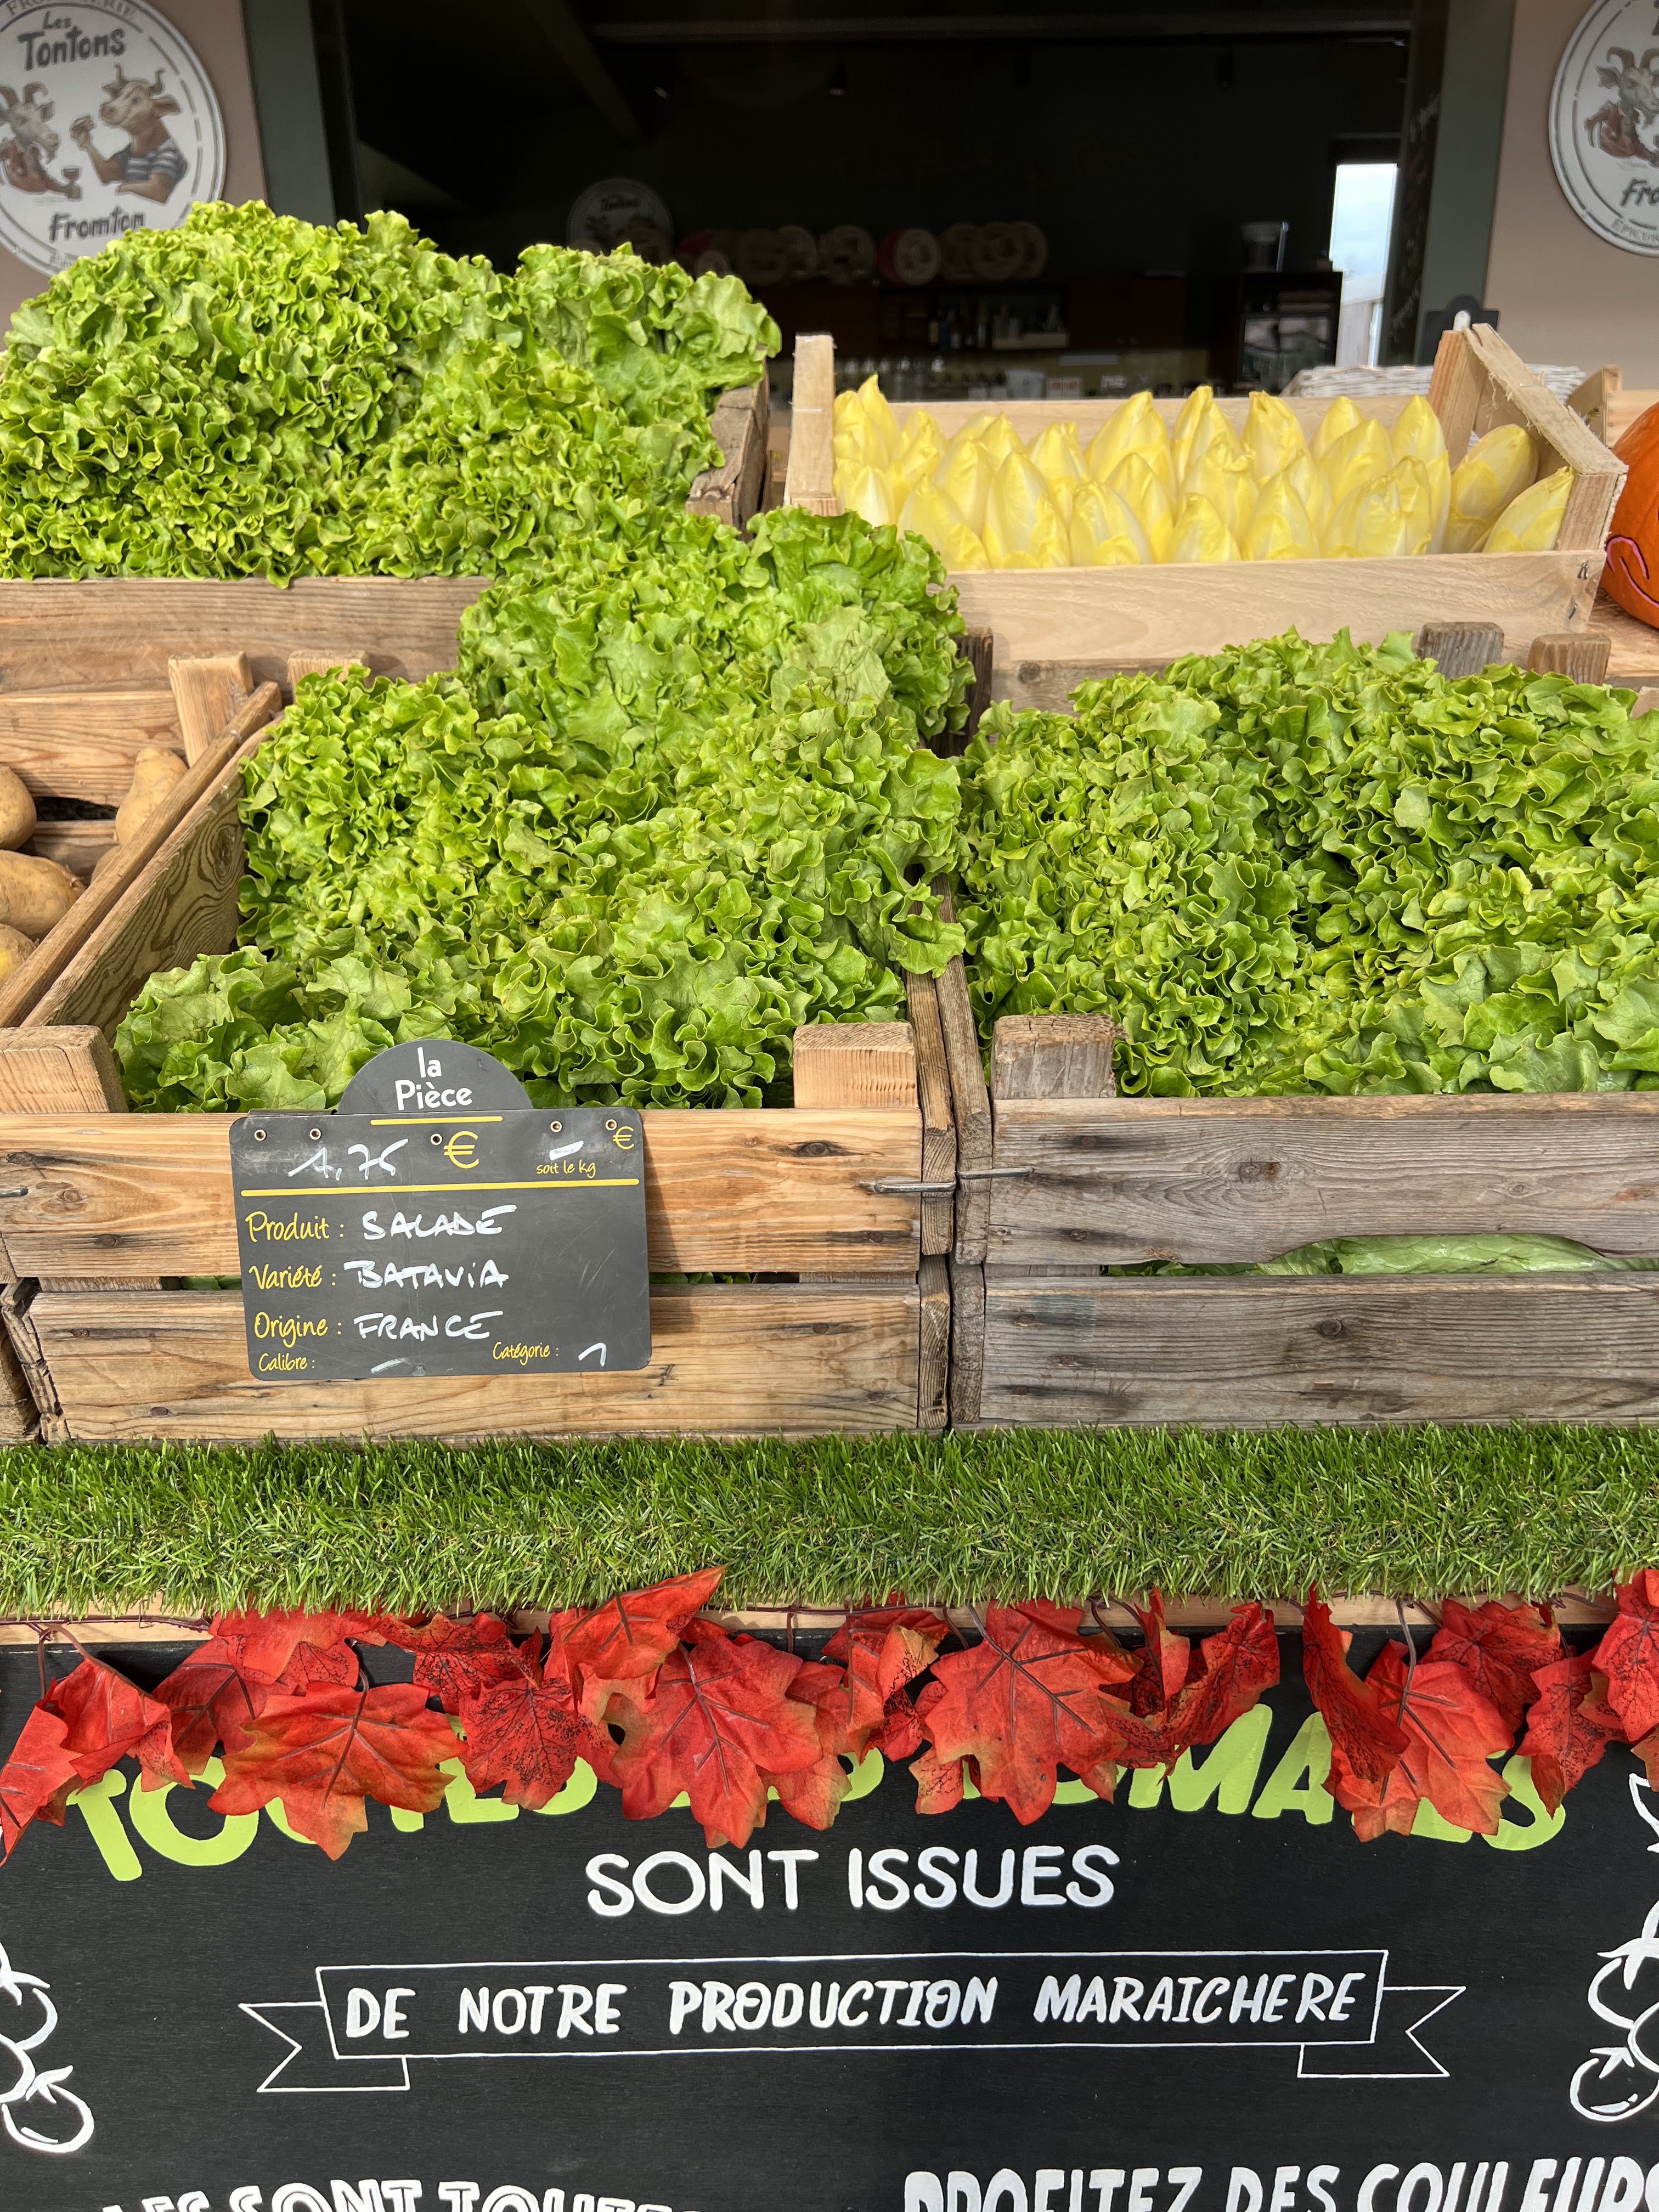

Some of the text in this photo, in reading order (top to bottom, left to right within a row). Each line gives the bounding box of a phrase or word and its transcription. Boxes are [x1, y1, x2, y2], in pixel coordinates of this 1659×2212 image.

[43, 10, 71, 29] Les
[18, 25, 127, 71] Tontons
[49, 206, 146, 242] Fromton
[417, 1047, 442, 1078] la
[395, 1080, 472, 1111] Pièce
[536, 1159, 596, 1179] soit le kg
[362, 1204, 517, 1240] SALADE
[353, 1310, 504, 1342] FRANCE
[585, 1844, 1120, 1917] SONT ISSUES
[346, 1972, 1366, 2039] DE NOTRE PRODUCTION MARAICHERE
